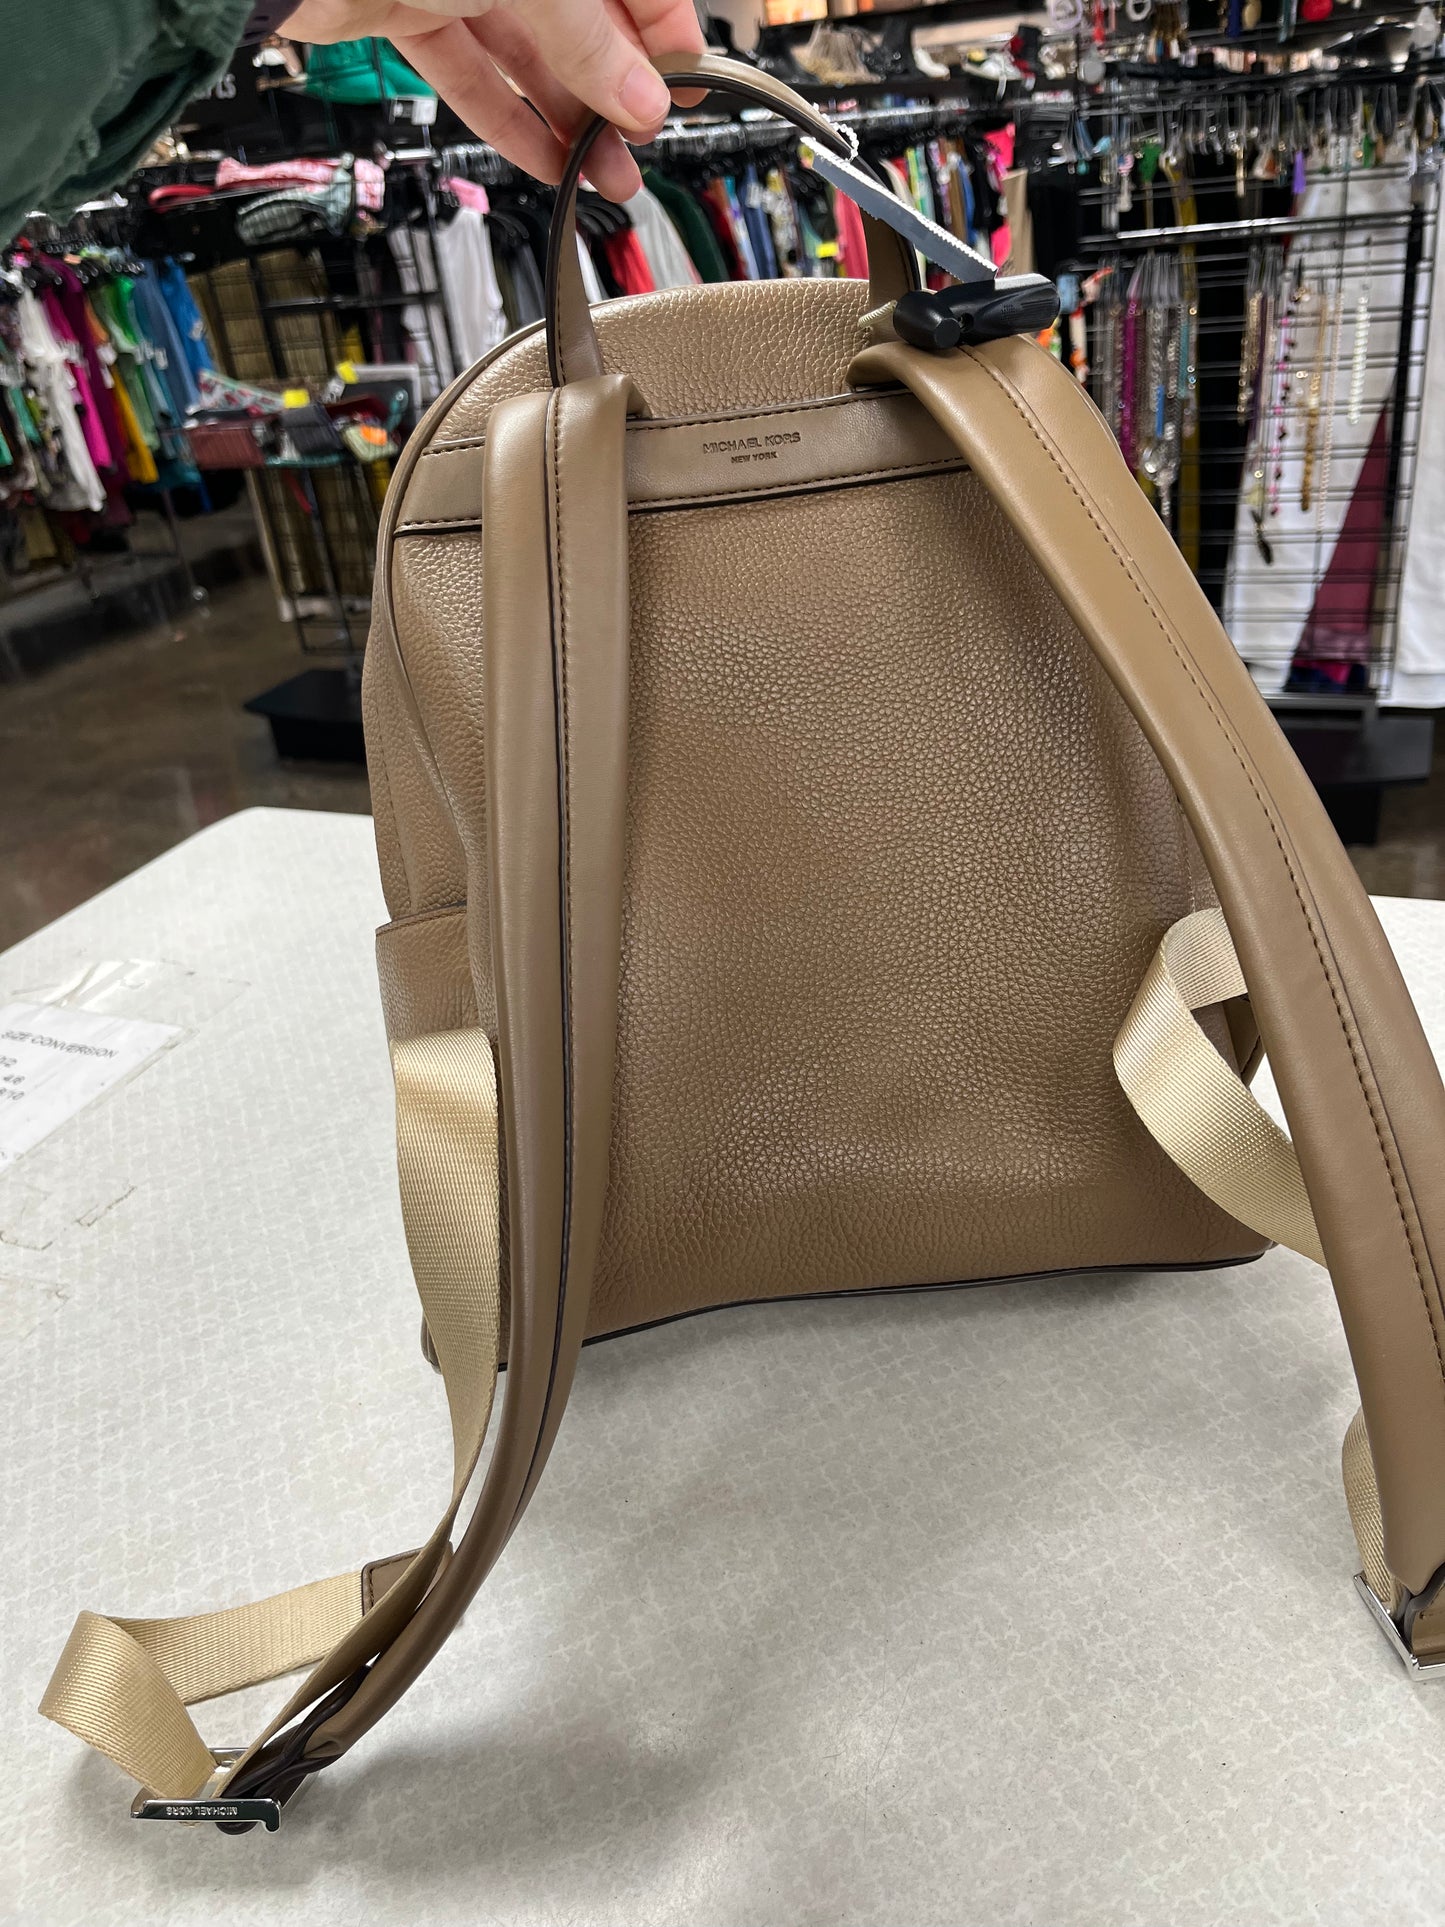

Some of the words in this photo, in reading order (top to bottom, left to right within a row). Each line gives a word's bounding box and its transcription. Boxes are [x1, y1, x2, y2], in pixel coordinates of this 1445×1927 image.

[702, 437, 762, 454] MICHAEL
[765, 432, 801, 446] KORS
[731, 454, 750, 463] NEW
[752, 451, 778, 461] YORK
[31, 1035, 119, 1058] CONVERSION
[165, 1806, 193, 1816] KORS
[194, 1806, 238, 1816] MICHAEL
